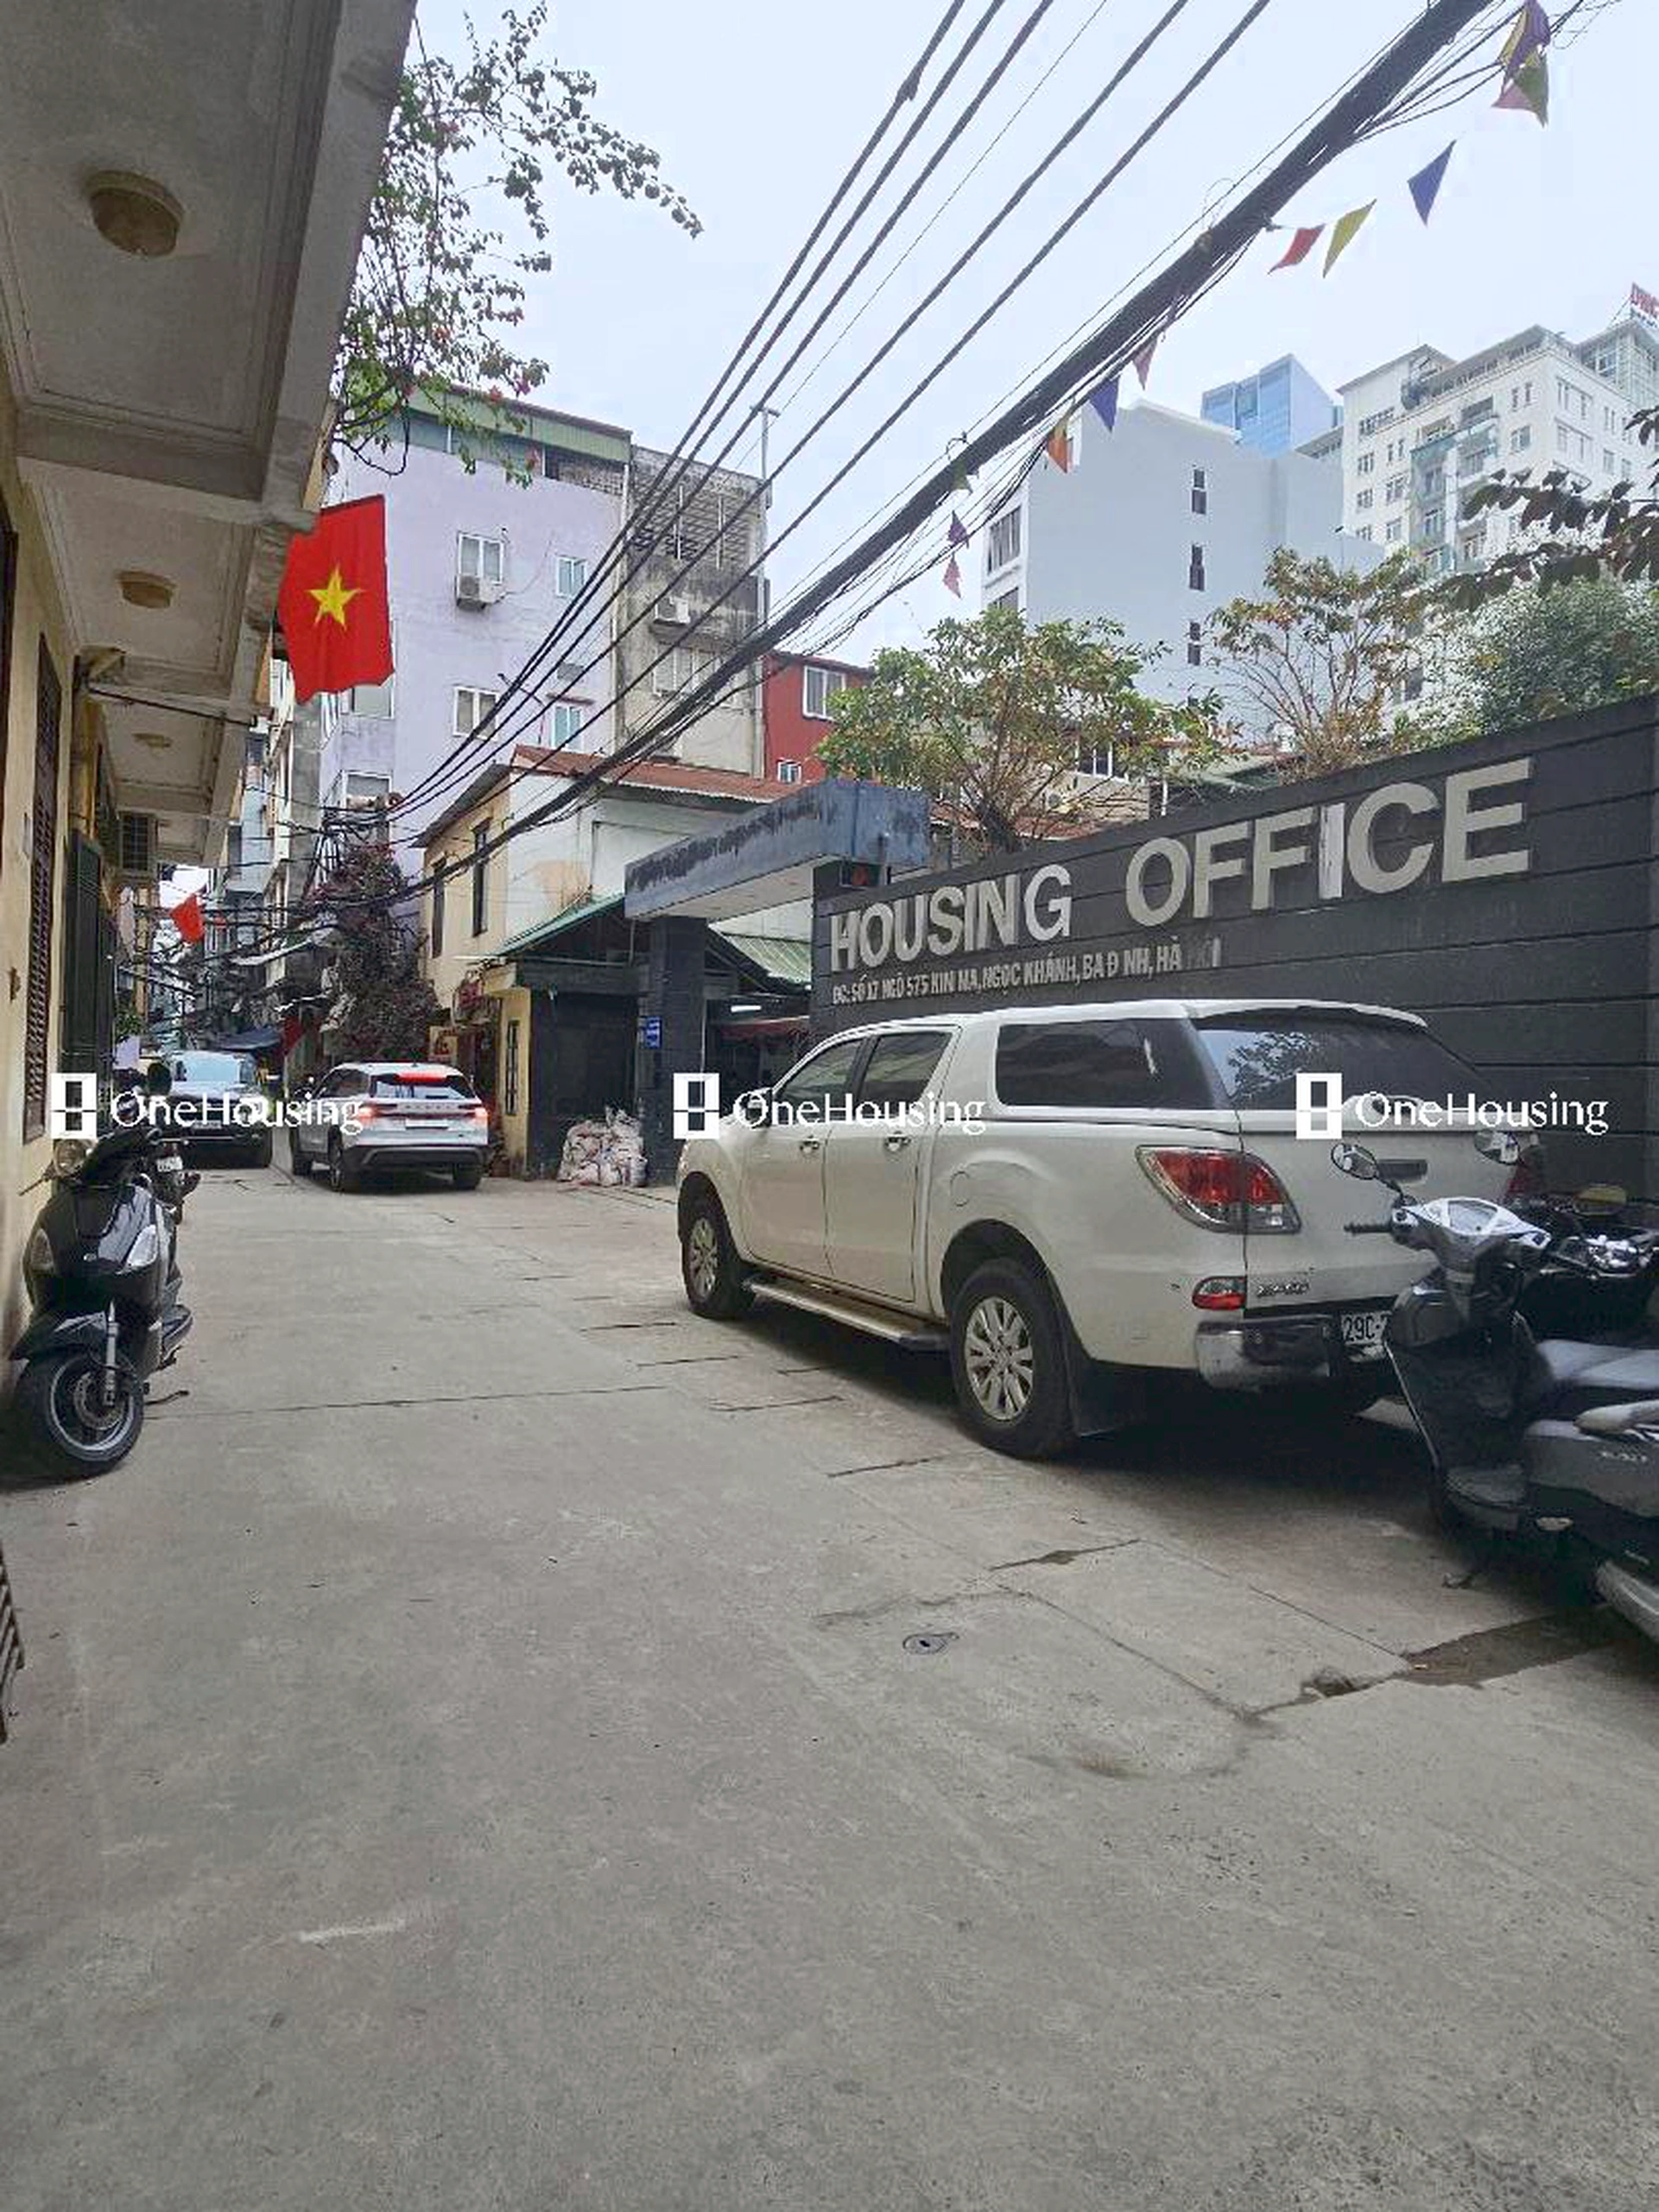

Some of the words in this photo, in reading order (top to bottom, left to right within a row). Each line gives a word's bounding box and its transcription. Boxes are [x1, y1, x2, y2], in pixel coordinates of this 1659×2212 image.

[831, 865, 1073, 972] HOUSING
[1126, 757, 1532, 927] OFFICE
[906, 974, 929, 997] 575
[982, 962, 1022, 995] NGỌC
